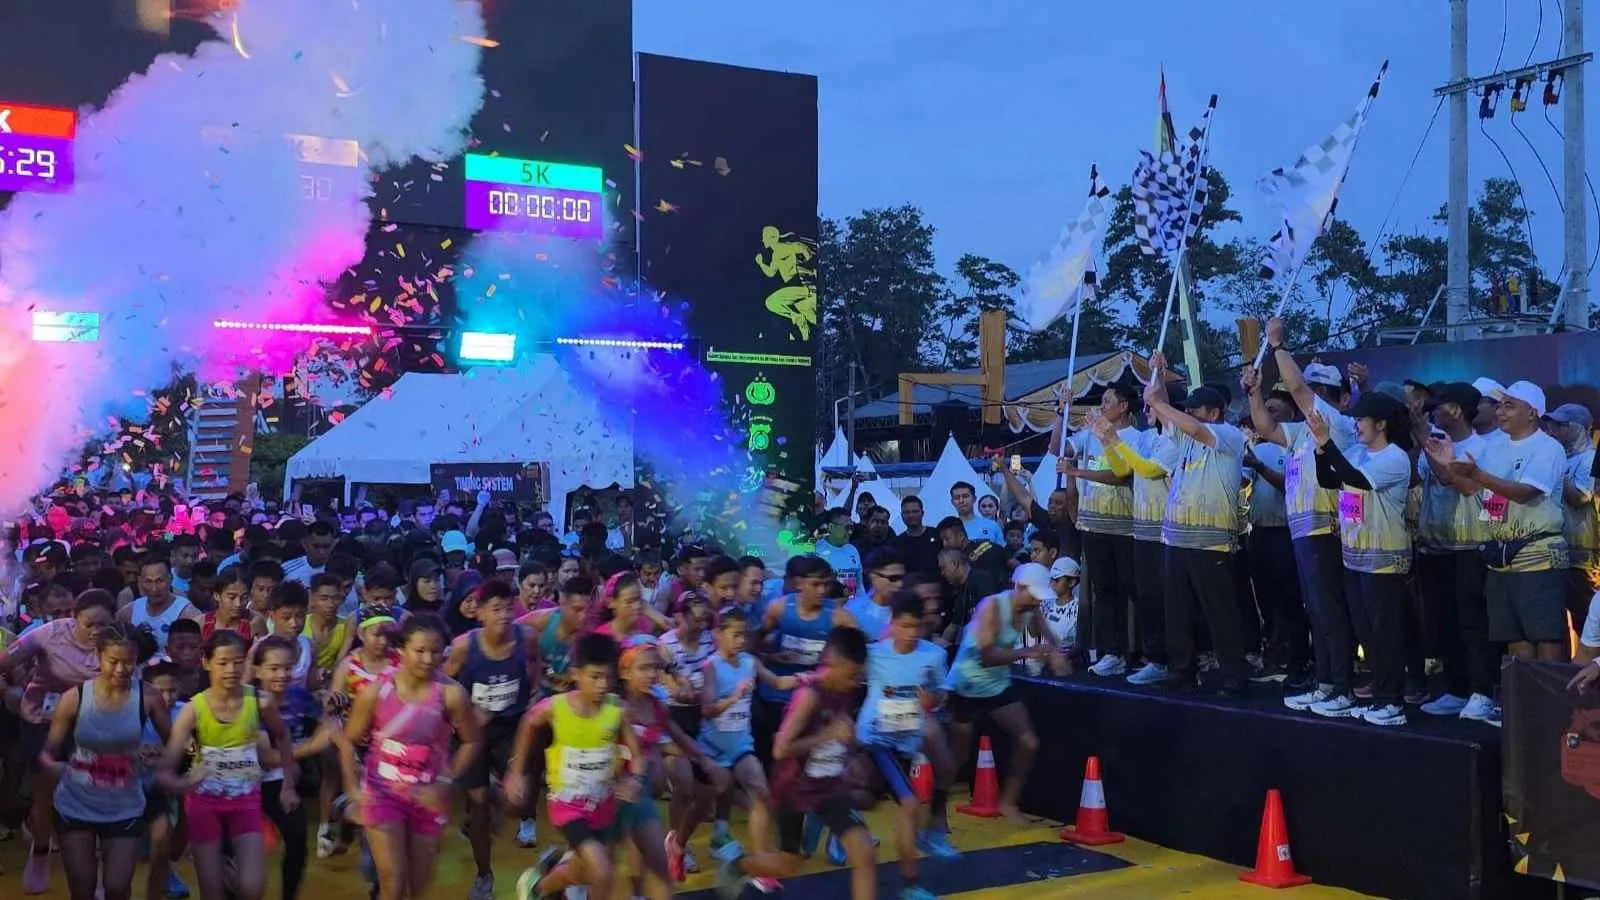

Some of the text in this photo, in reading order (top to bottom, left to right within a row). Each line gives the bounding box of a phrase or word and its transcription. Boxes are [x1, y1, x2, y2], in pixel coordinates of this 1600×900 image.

[489, 190, 591, 223] 00:00:00
[454, 476, 514, 493] TIMING SYSTEM
